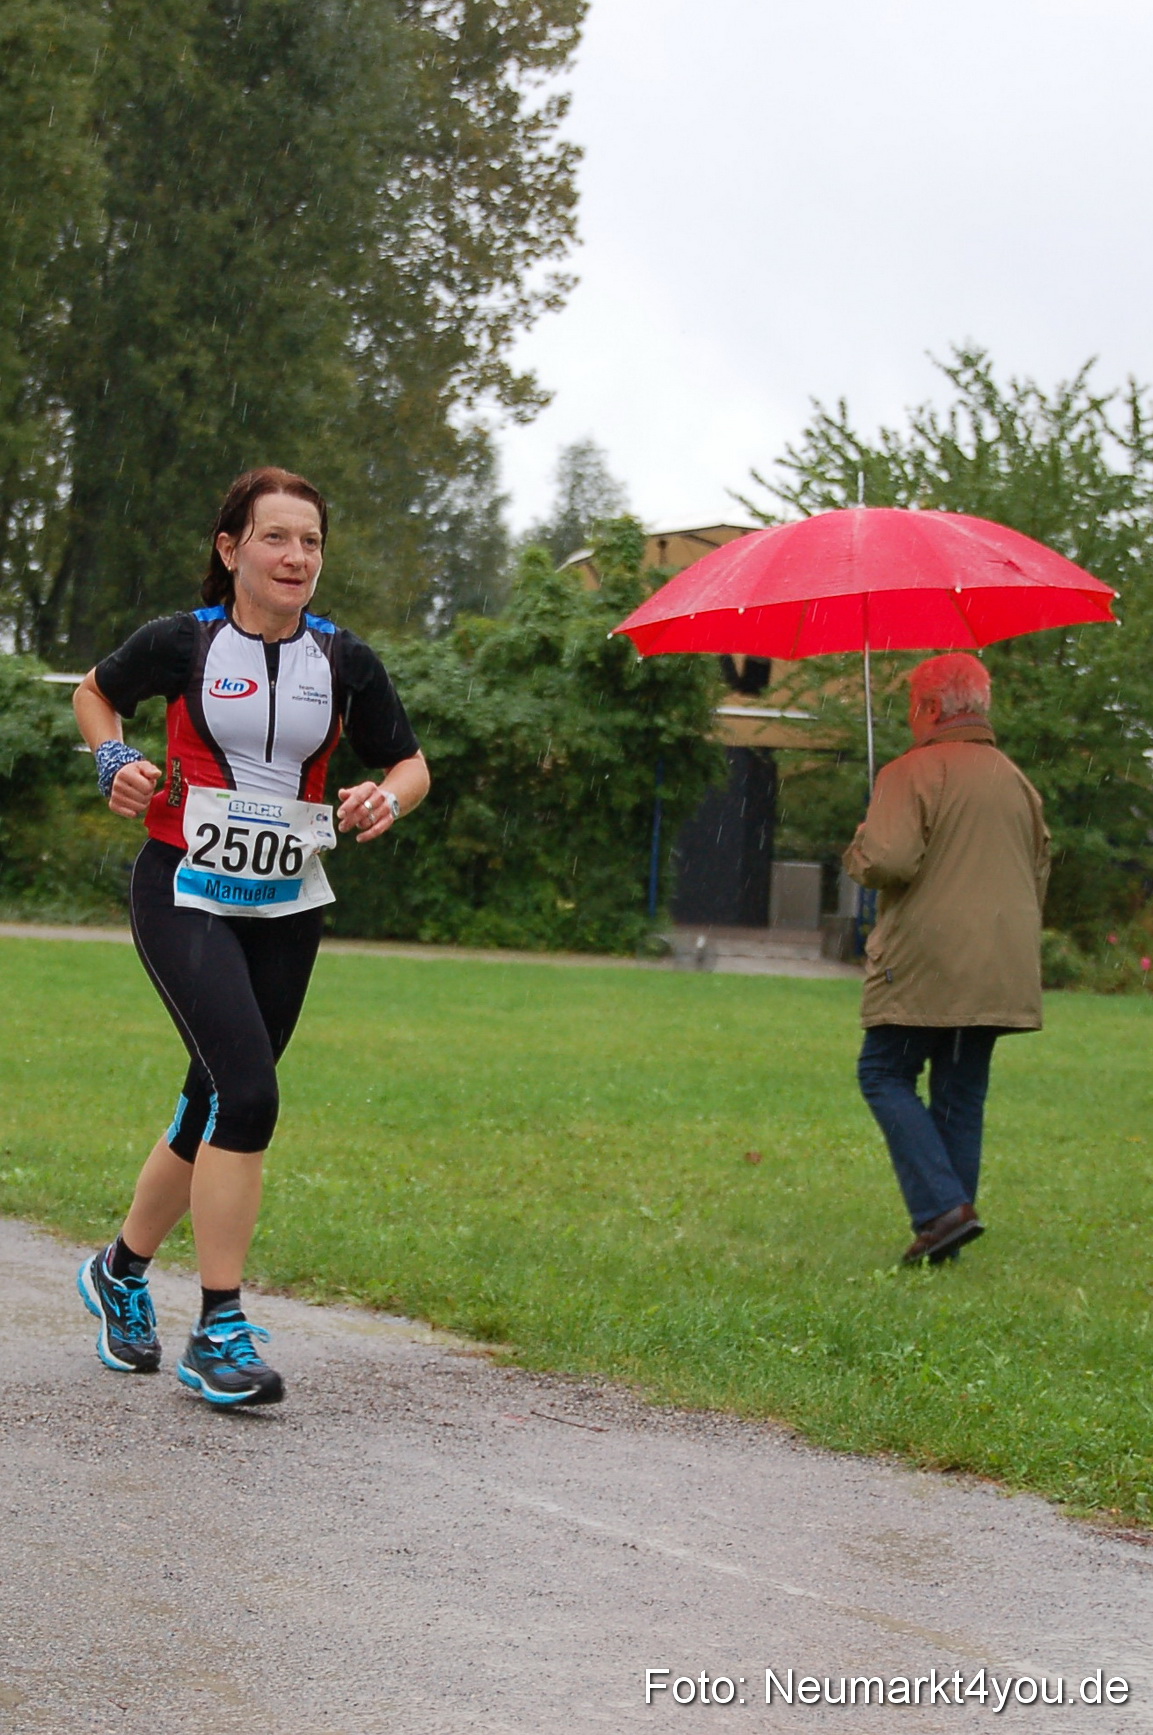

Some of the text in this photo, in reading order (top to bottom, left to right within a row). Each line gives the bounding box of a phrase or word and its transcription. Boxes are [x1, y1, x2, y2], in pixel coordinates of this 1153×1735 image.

[213, 677, 245, 691] tkn
[228, 800, 283, 818] BOCK
[192, 823, 304, 877] 2506
[205, 879, 277, 902] Manuela
